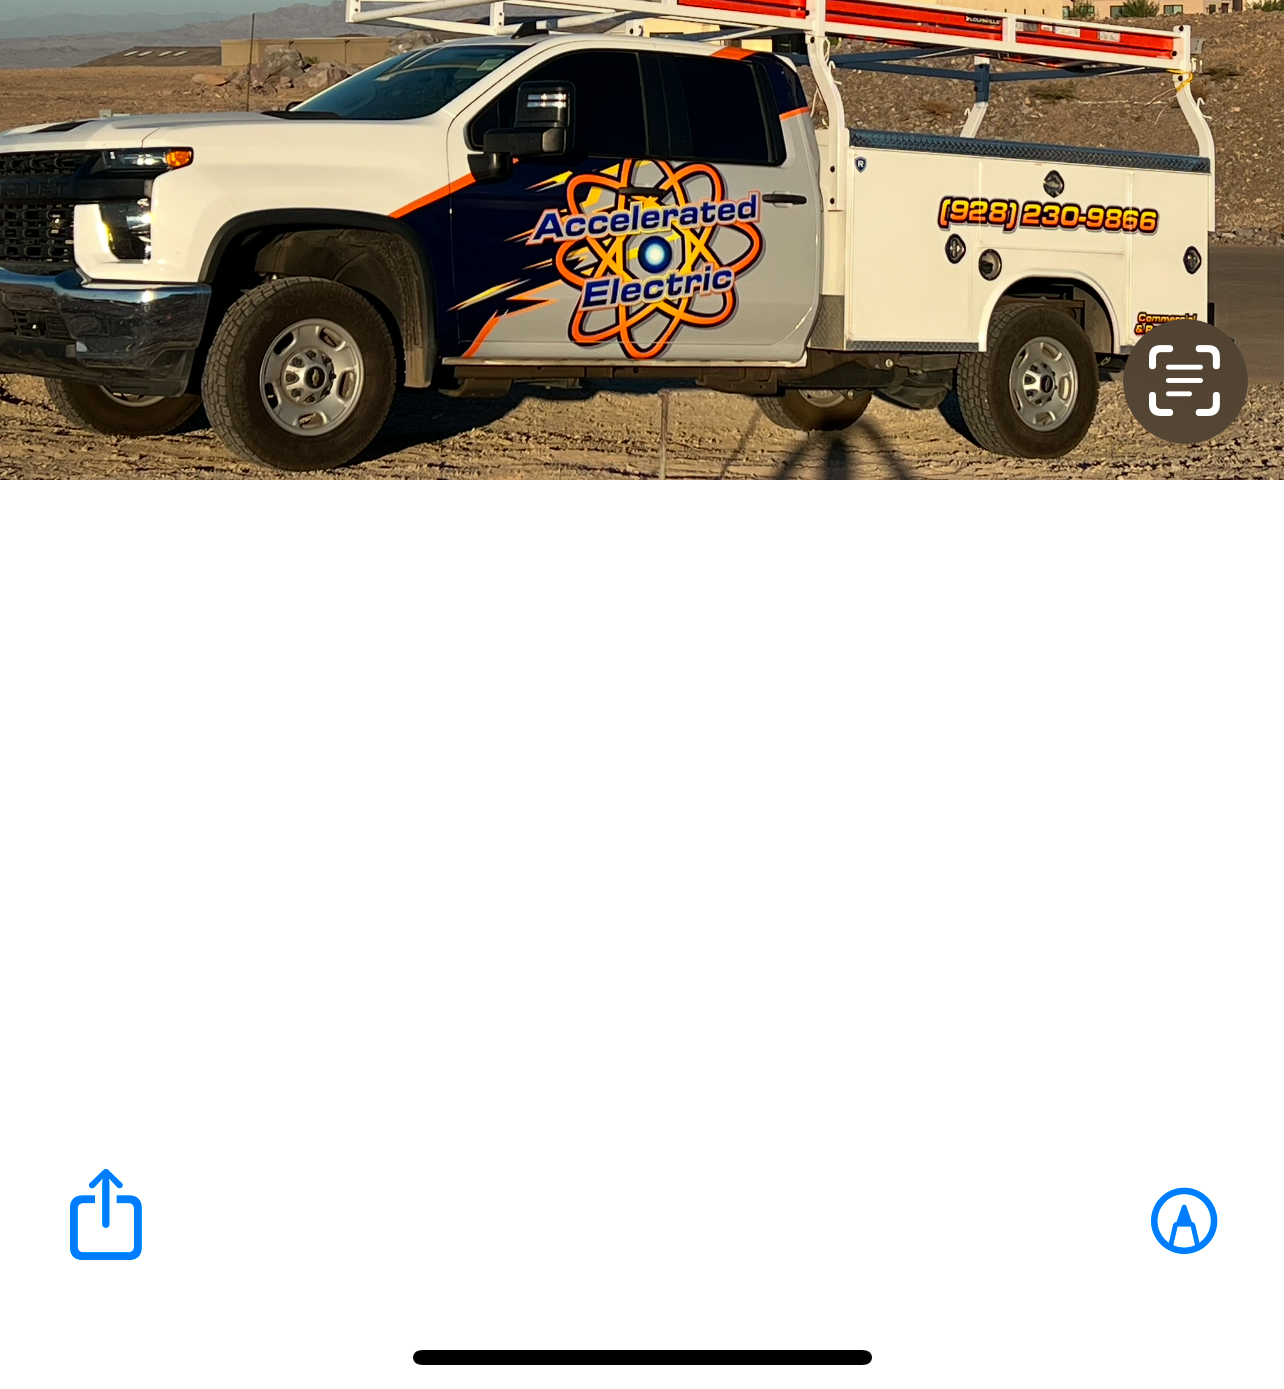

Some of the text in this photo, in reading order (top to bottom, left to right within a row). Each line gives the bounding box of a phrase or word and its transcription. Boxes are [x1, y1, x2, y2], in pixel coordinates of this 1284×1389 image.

[529, 191, 760, 244] Accelerated
[938, 196, 1158, 234] (928) 230-9866
[580, 263, 735, 309] Electric
